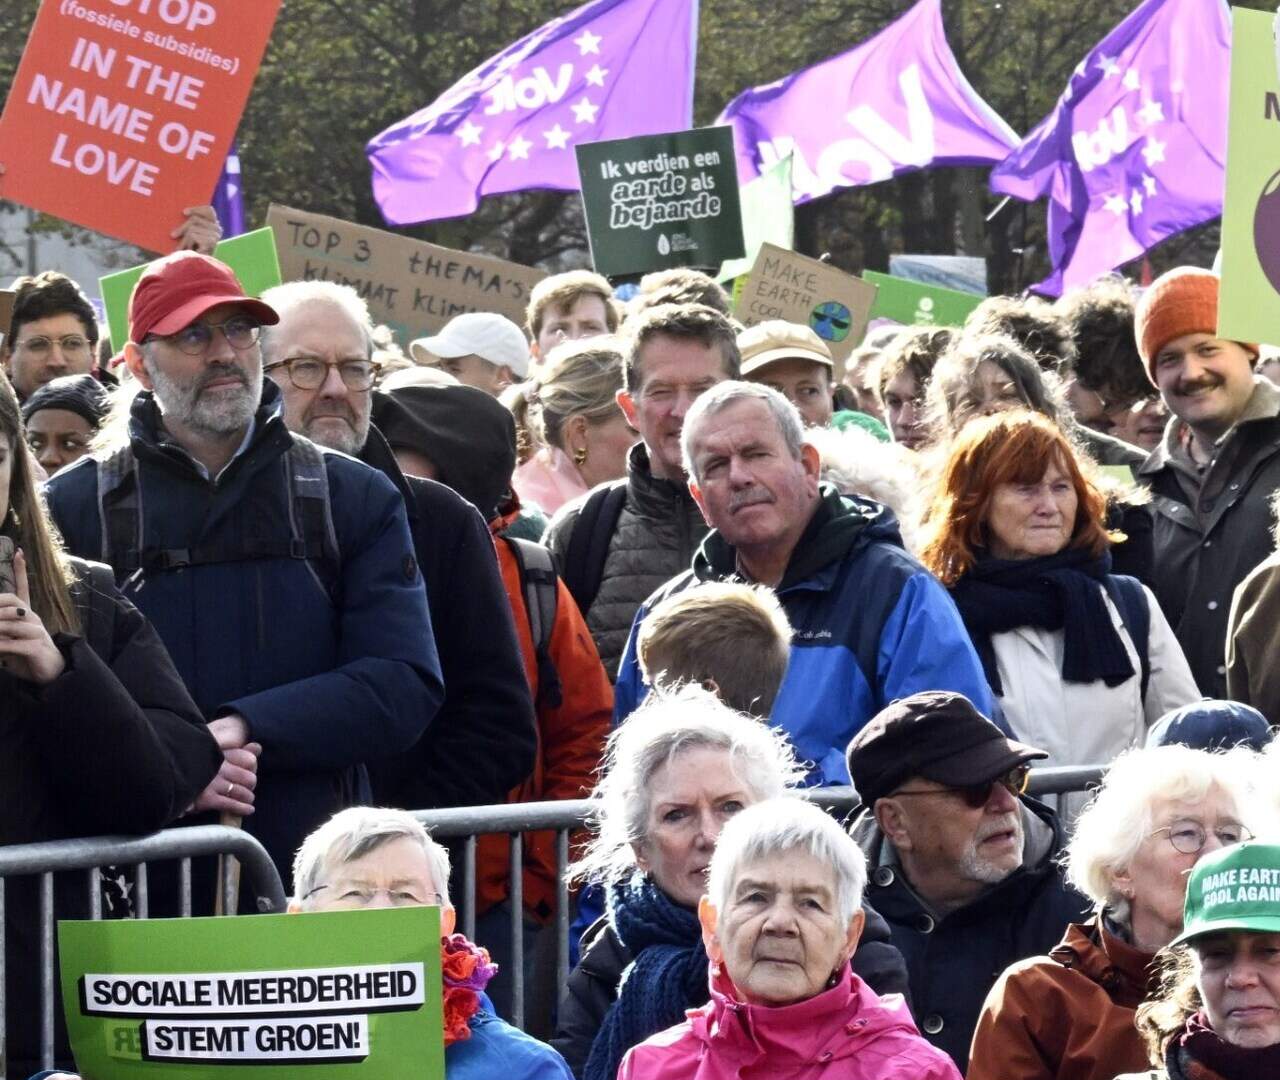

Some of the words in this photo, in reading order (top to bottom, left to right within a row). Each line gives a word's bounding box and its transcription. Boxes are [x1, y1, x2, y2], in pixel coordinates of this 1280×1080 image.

[60, 0, 140, 38] (fossiele
[143, 30, 240, 75] subsidies)
[70, 38, 117, 79] IN
[125, 55, 204, 110] THE
[28, 73, 154, 143] NAME
[158, 122, 215, 161] OF
[50, 133, 160, 196] LOVE
[600, 160, 621, 179] Ik
[625, 153, 689, 175] verdien
[694, 151, 720, 167] een
[611, 171, 686, 202] aarde
[690, 172, 715, 191] als
[610, 192, 721, 230] bejaarde
[287, 220, 341, 253] TOP
[354, 239, 371, 262] 3
[762, 258, 817, 293] MAKE
[750, 300, 785, 320] COOL
[756, 281, 812, 307] EARTH
[1201, 869, 1237, 892] MAKE
[1203, 891, 1234, 909] COOL
[92, 979, 211, 1006] SOCIALE
[217, 970, 417, 1007] MEERDERHEID
[154, 1025, 249, 1052] STEMT
[255, 1022, 360, 1052] GROEN!
